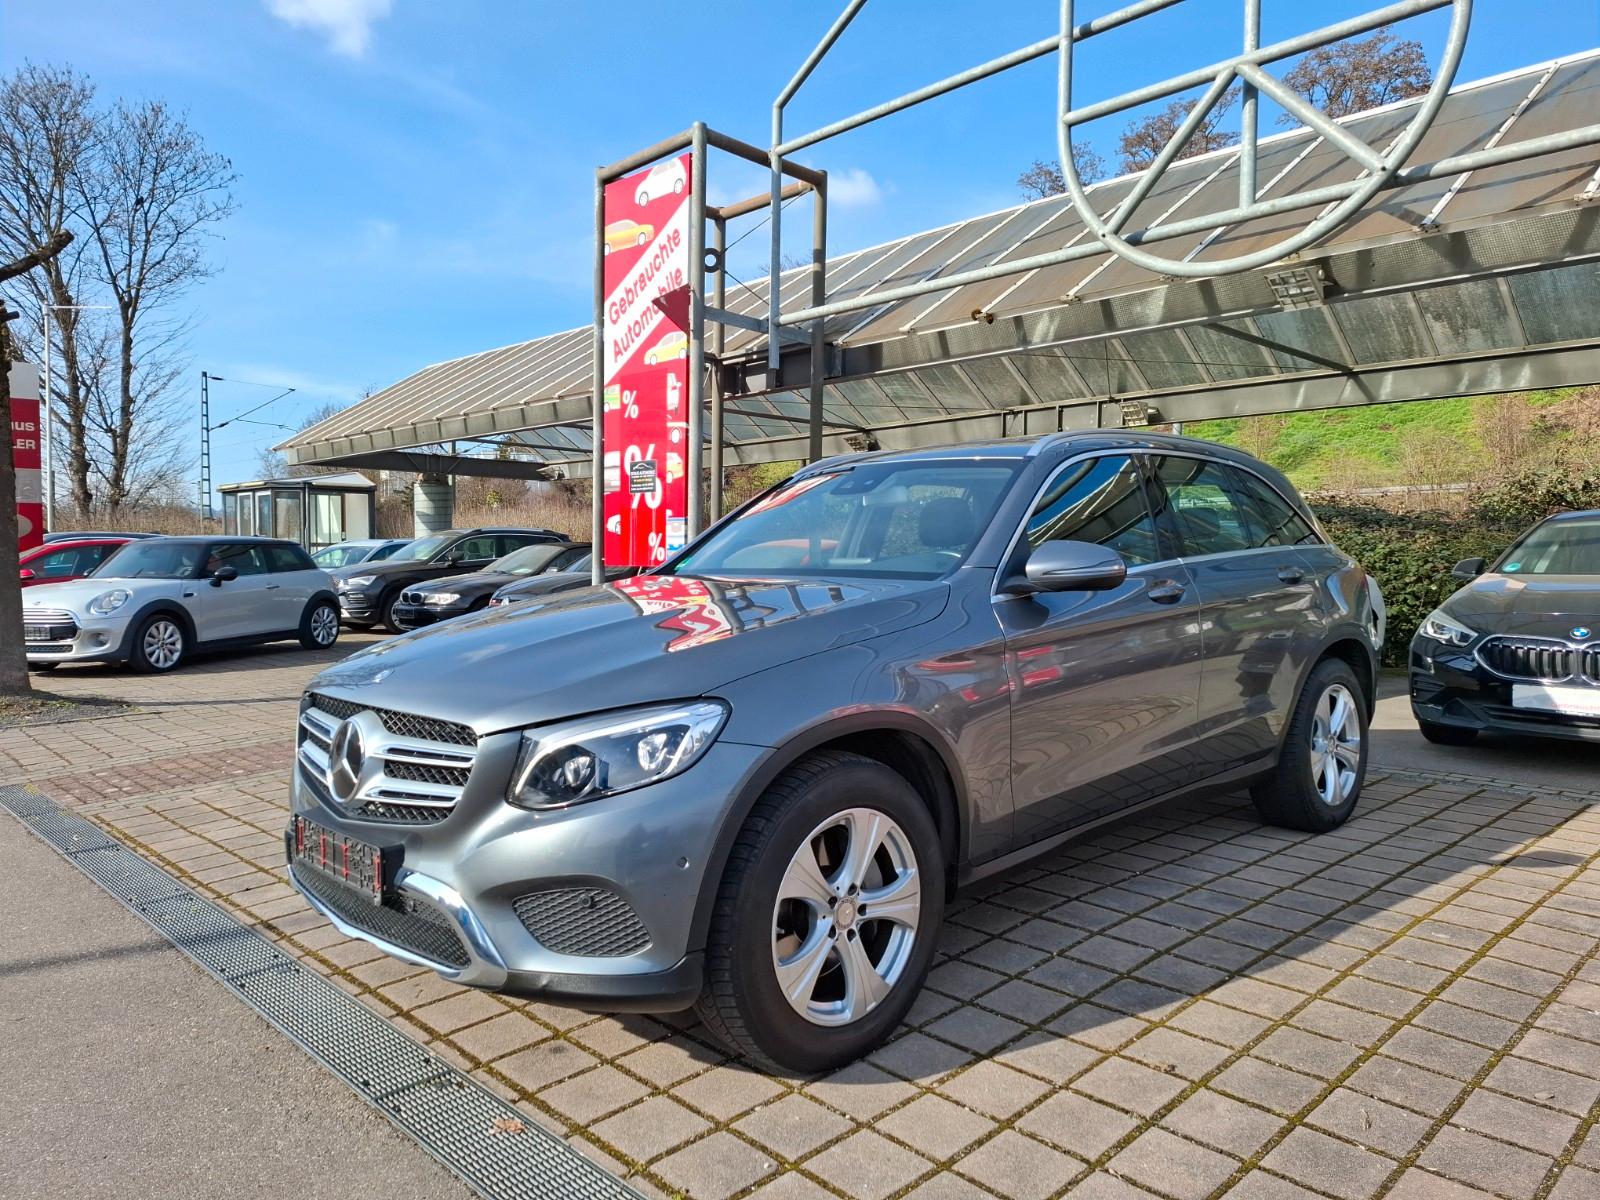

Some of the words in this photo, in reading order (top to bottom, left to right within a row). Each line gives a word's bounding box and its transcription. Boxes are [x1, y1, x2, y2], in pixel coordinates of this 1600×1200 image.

[609, 228, 681, 325] Gebrauchte
[11, 421, 35, 432] us
[12, 438, 36, 450] ER
